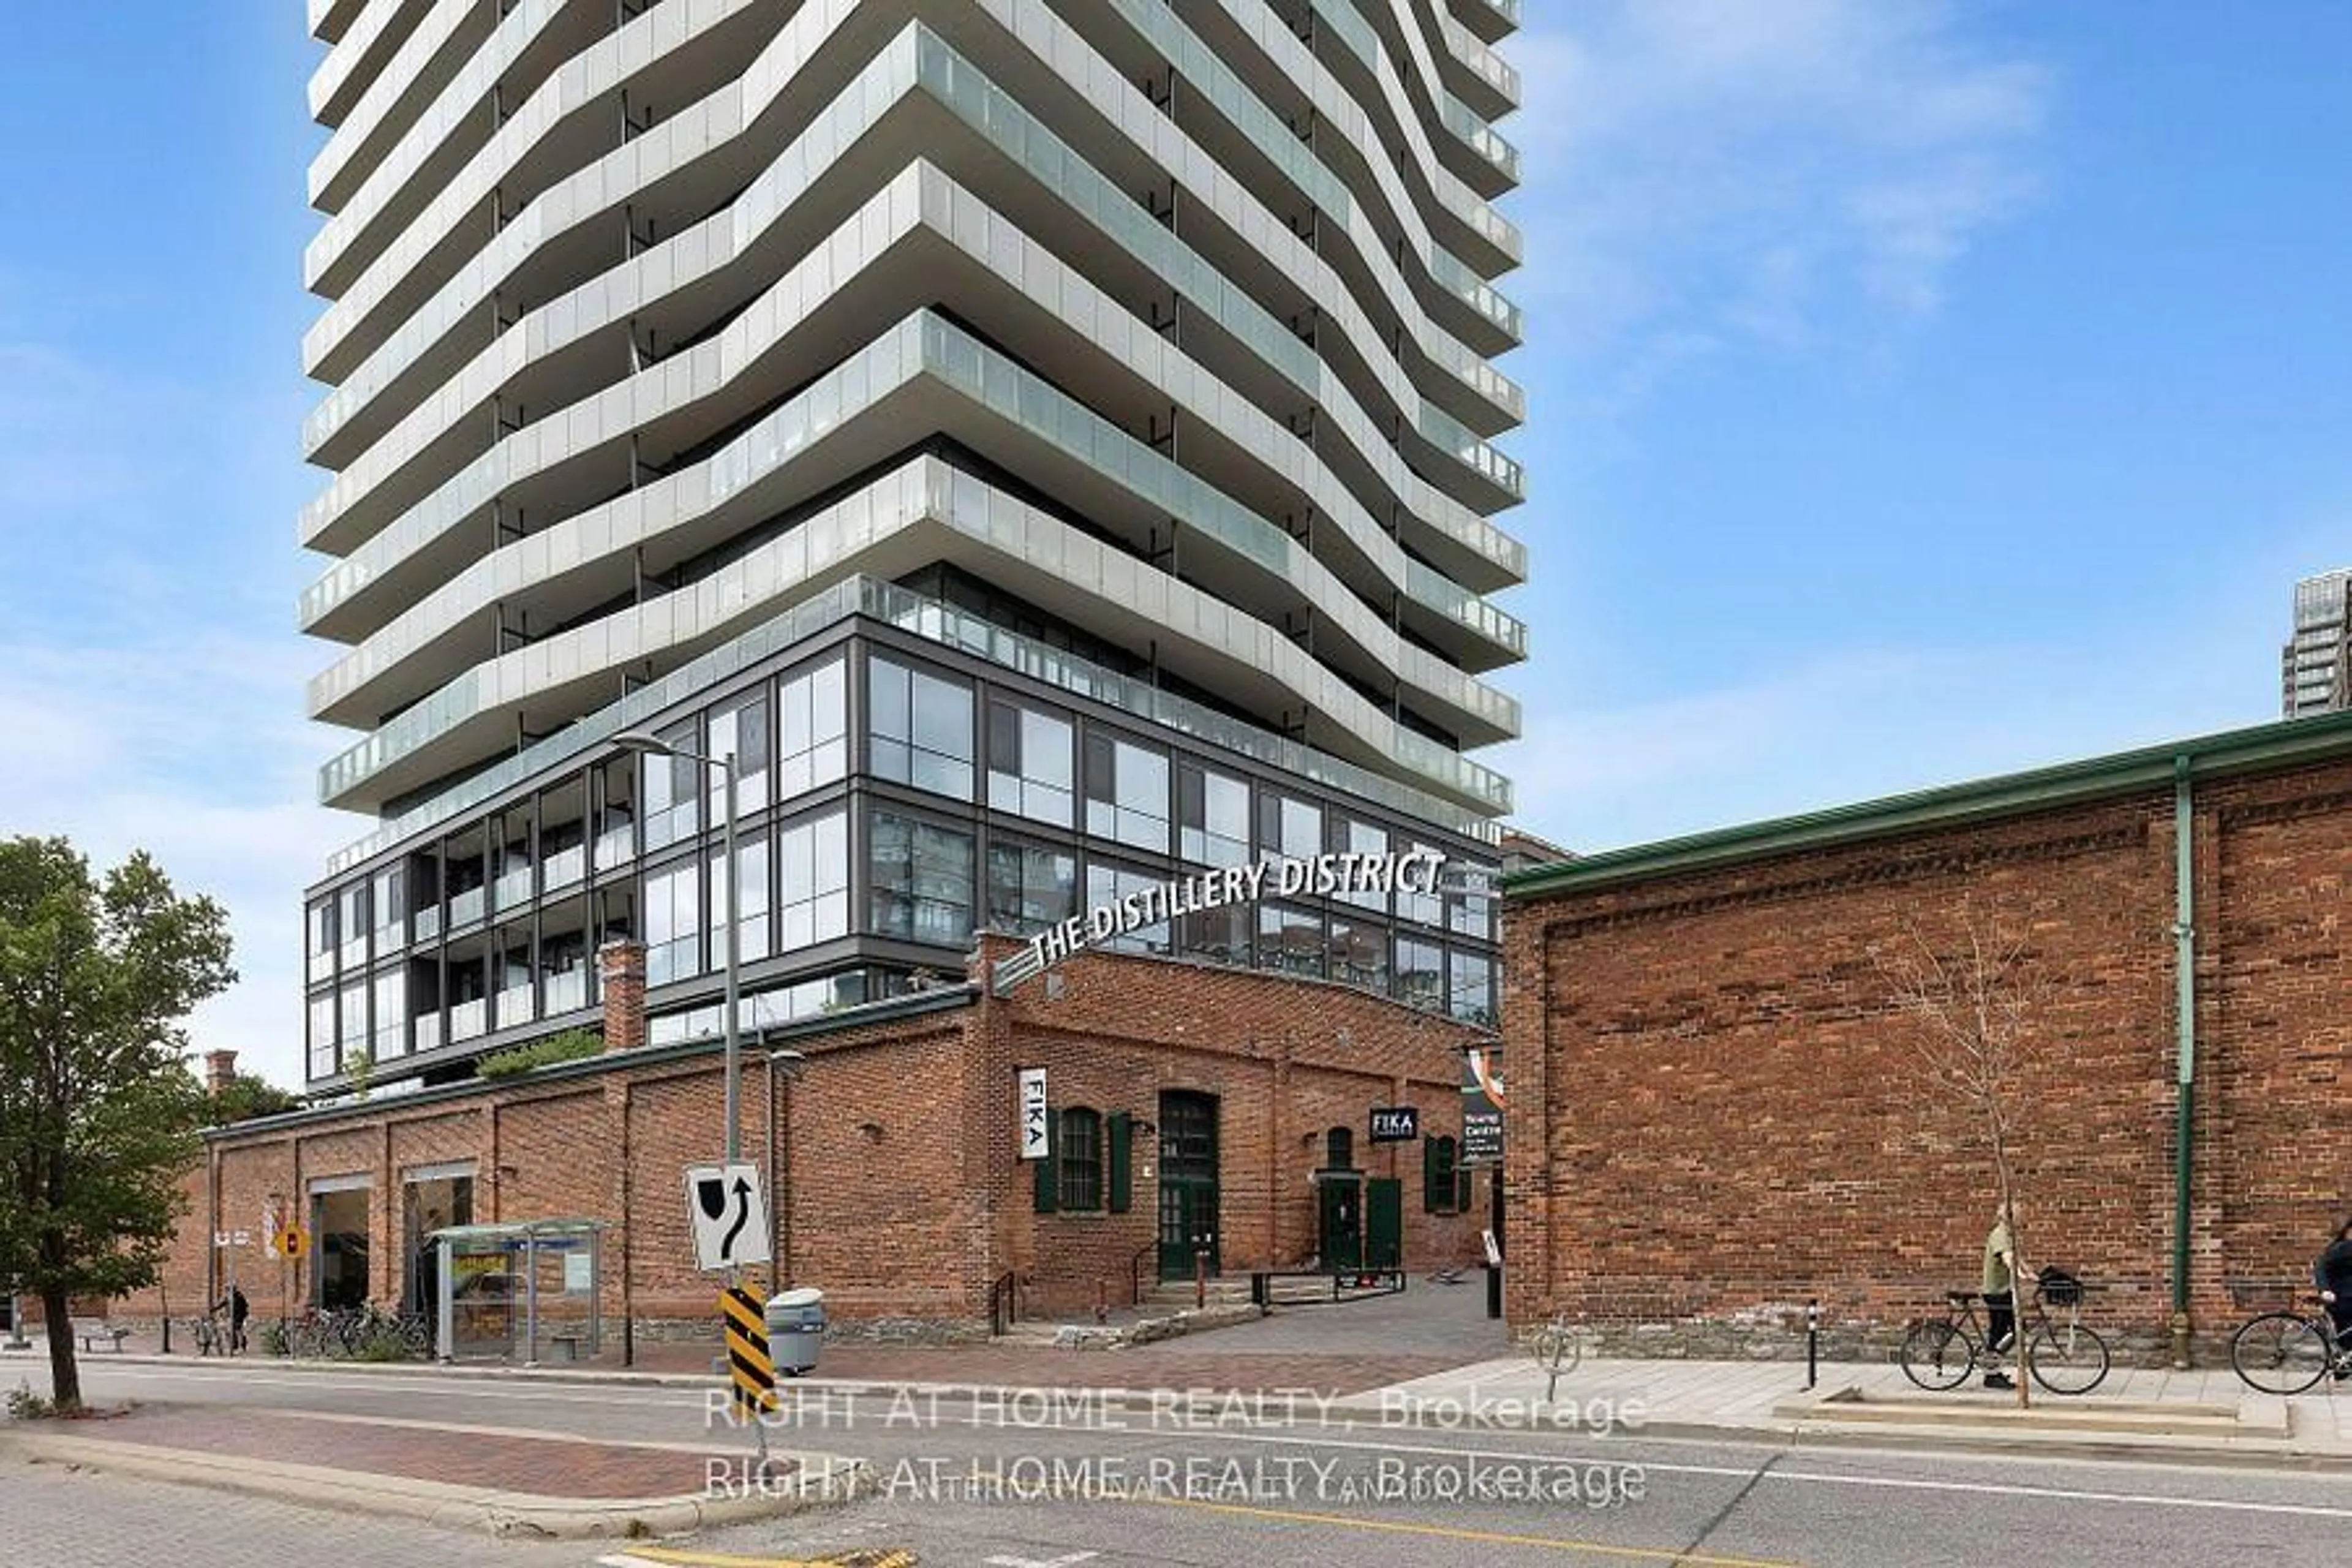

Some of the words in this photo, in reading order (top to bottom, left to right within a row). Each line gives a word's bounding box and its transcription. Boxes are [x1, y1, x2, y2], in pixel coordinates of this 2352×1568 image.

[1028, 915, 1088, 969] THE
[1093, 861, 1267, 940] DISTILLERY
[1280, 852, 1446, 896] DISTRICT
[1028, 1080, 1043, 1145] FIKA
[1373, 1114, 1412, 1133] FIKA
